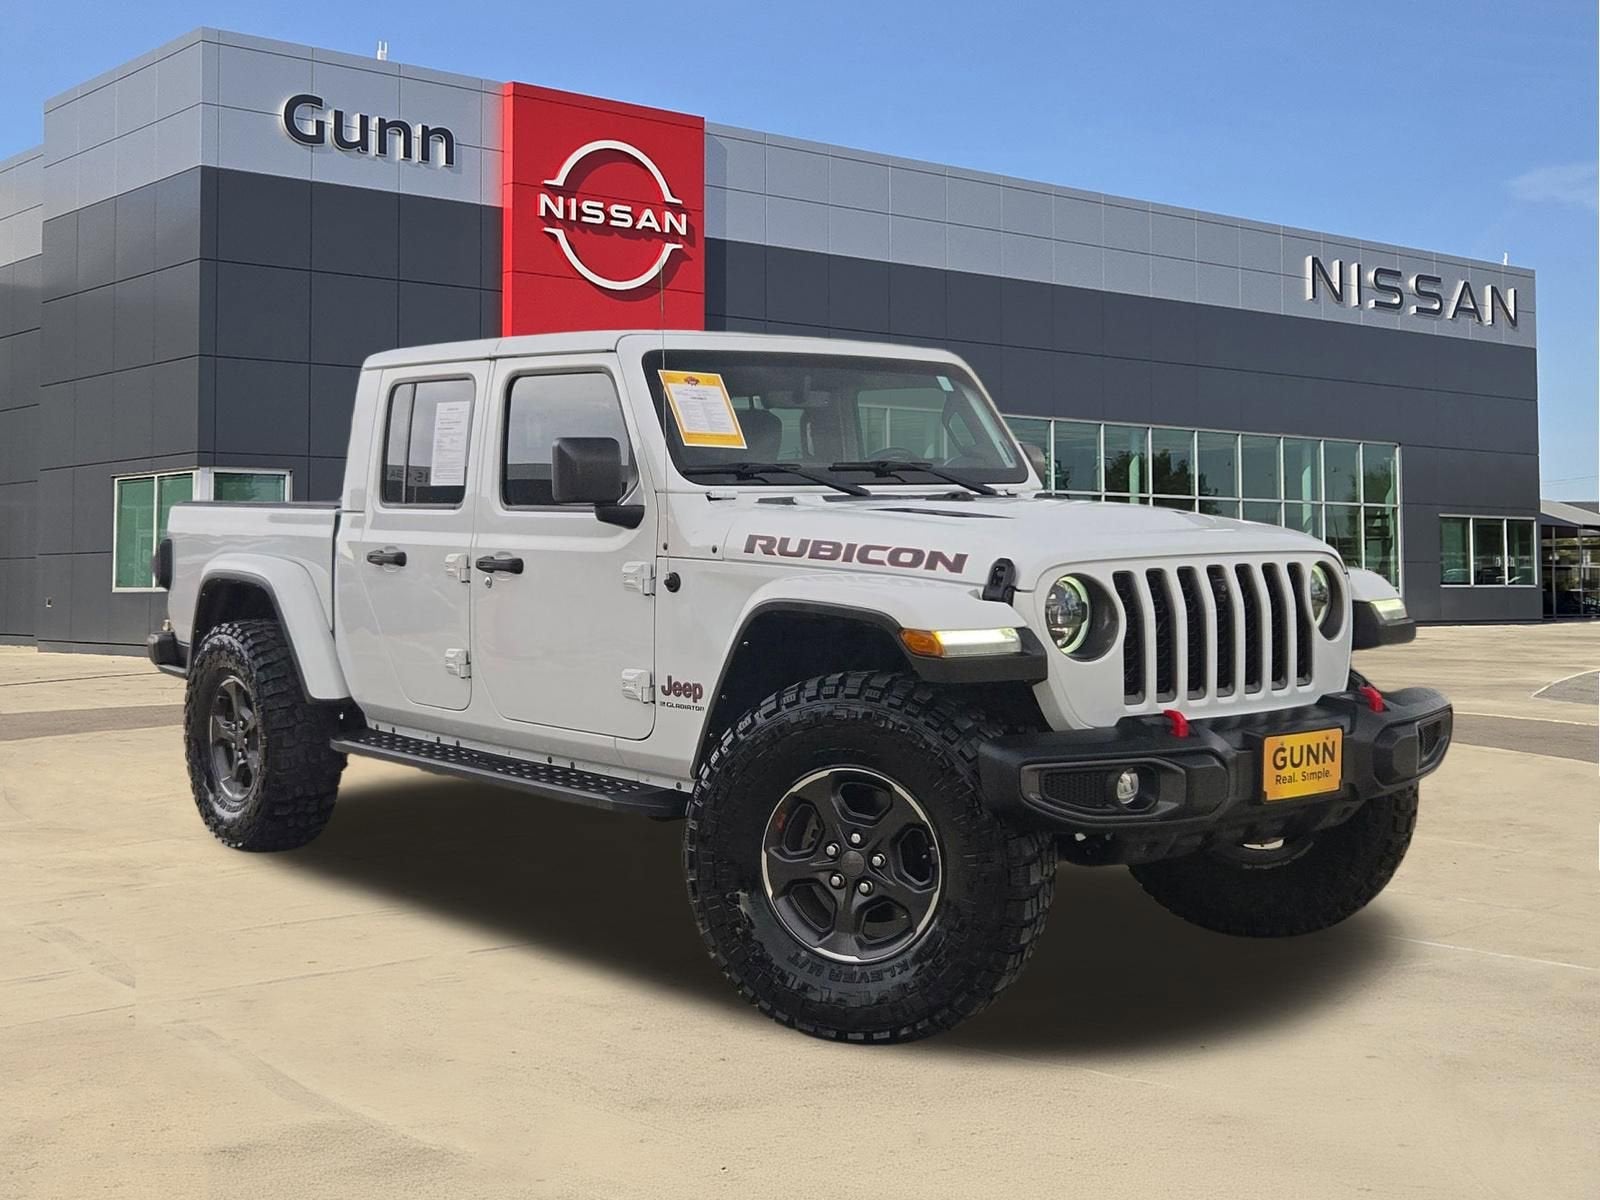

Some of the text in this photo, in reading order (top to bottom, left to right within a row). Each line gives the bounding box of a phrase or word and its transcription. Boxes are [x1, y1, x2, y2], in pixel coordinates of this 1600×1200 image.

[281, 93, 456, 167] Gunn
[537, 193, 687, 236] NISSAN
[1305, 255, 1518, 327] NISSAN
[744, 534, 969, 574] RUBICON
[661, 675, 703, 703] Jeep
[666, 701, 705, 711] GLADIATOR
[1272, 740, 1336, 770] GUNN
[1275, 772, 1298, 785] Real.
